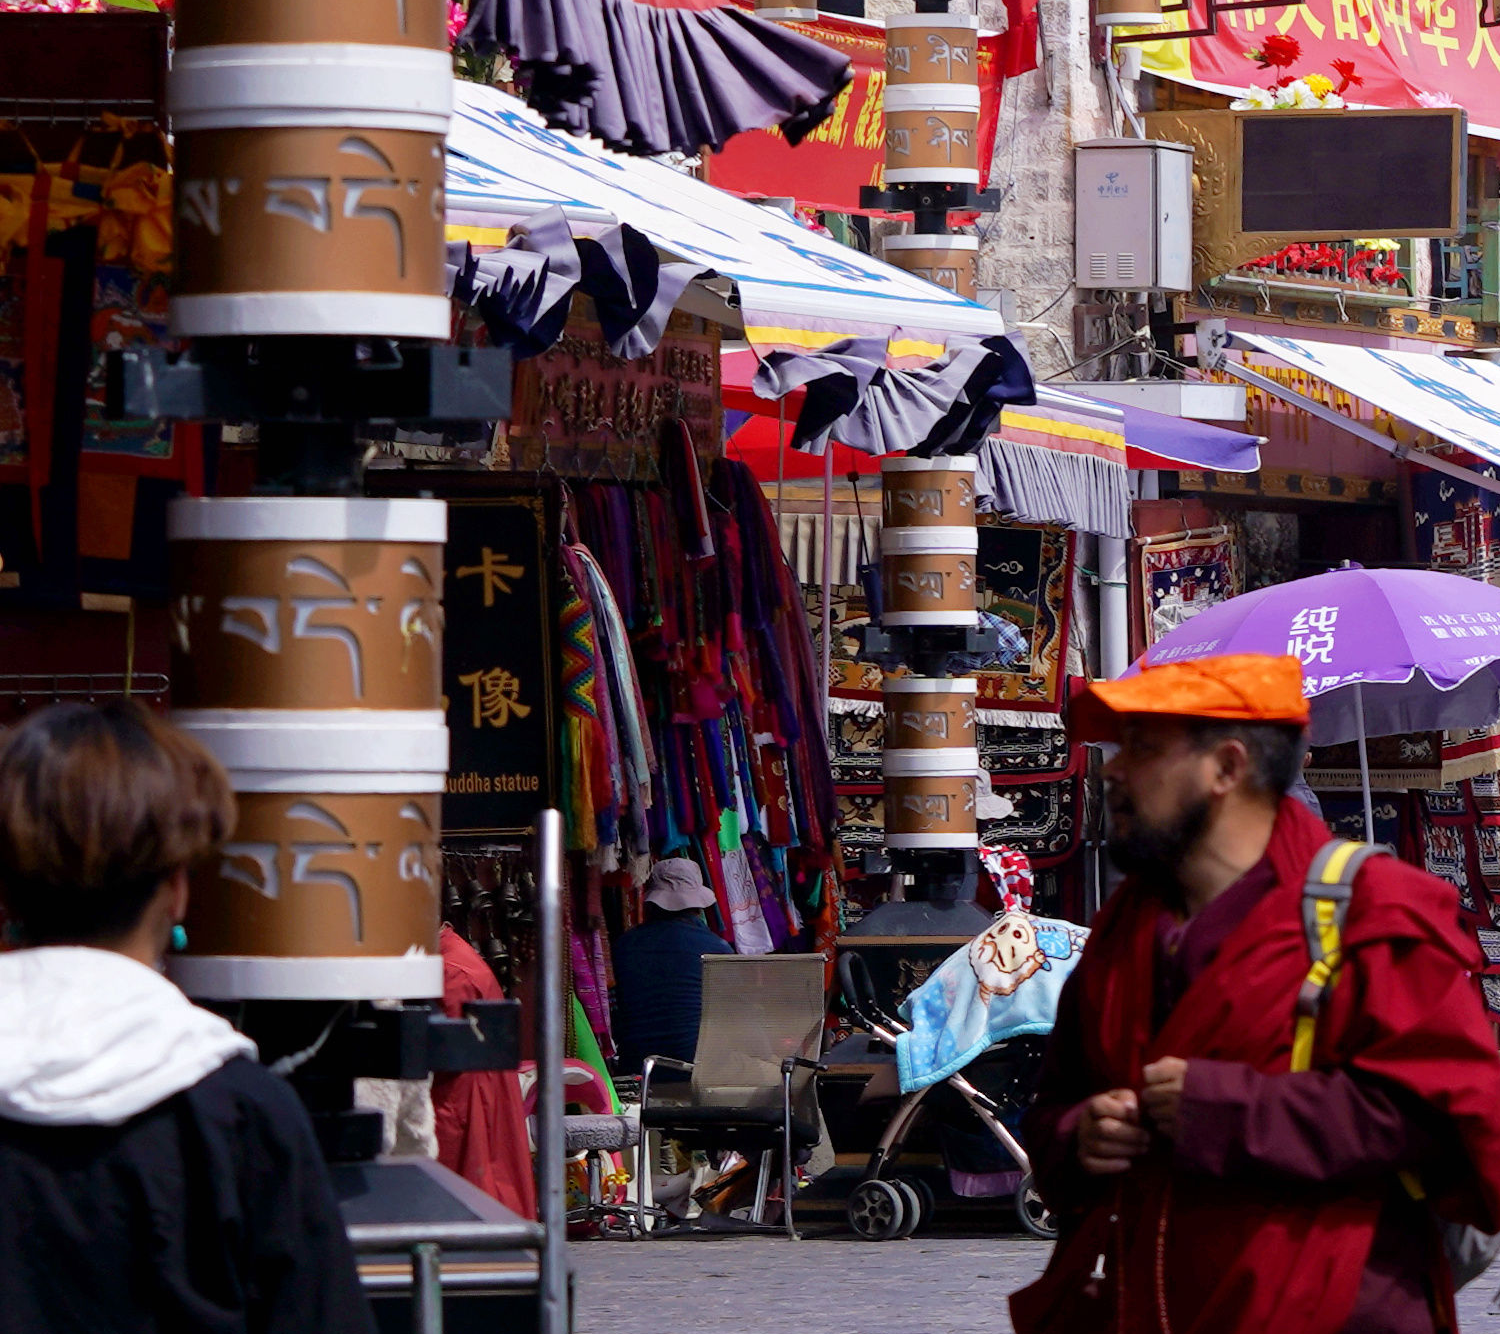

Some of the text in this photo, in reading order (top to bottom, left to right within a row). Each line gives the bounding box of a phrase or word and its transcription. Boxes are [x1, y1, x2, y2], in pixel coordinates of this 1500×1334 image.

[444, 546, 525, 608] 卡
[1287, 606, 1340, 666] 纯悦
[443, 667, 532, 729] 像
[494, 774, 539, 792] statue
